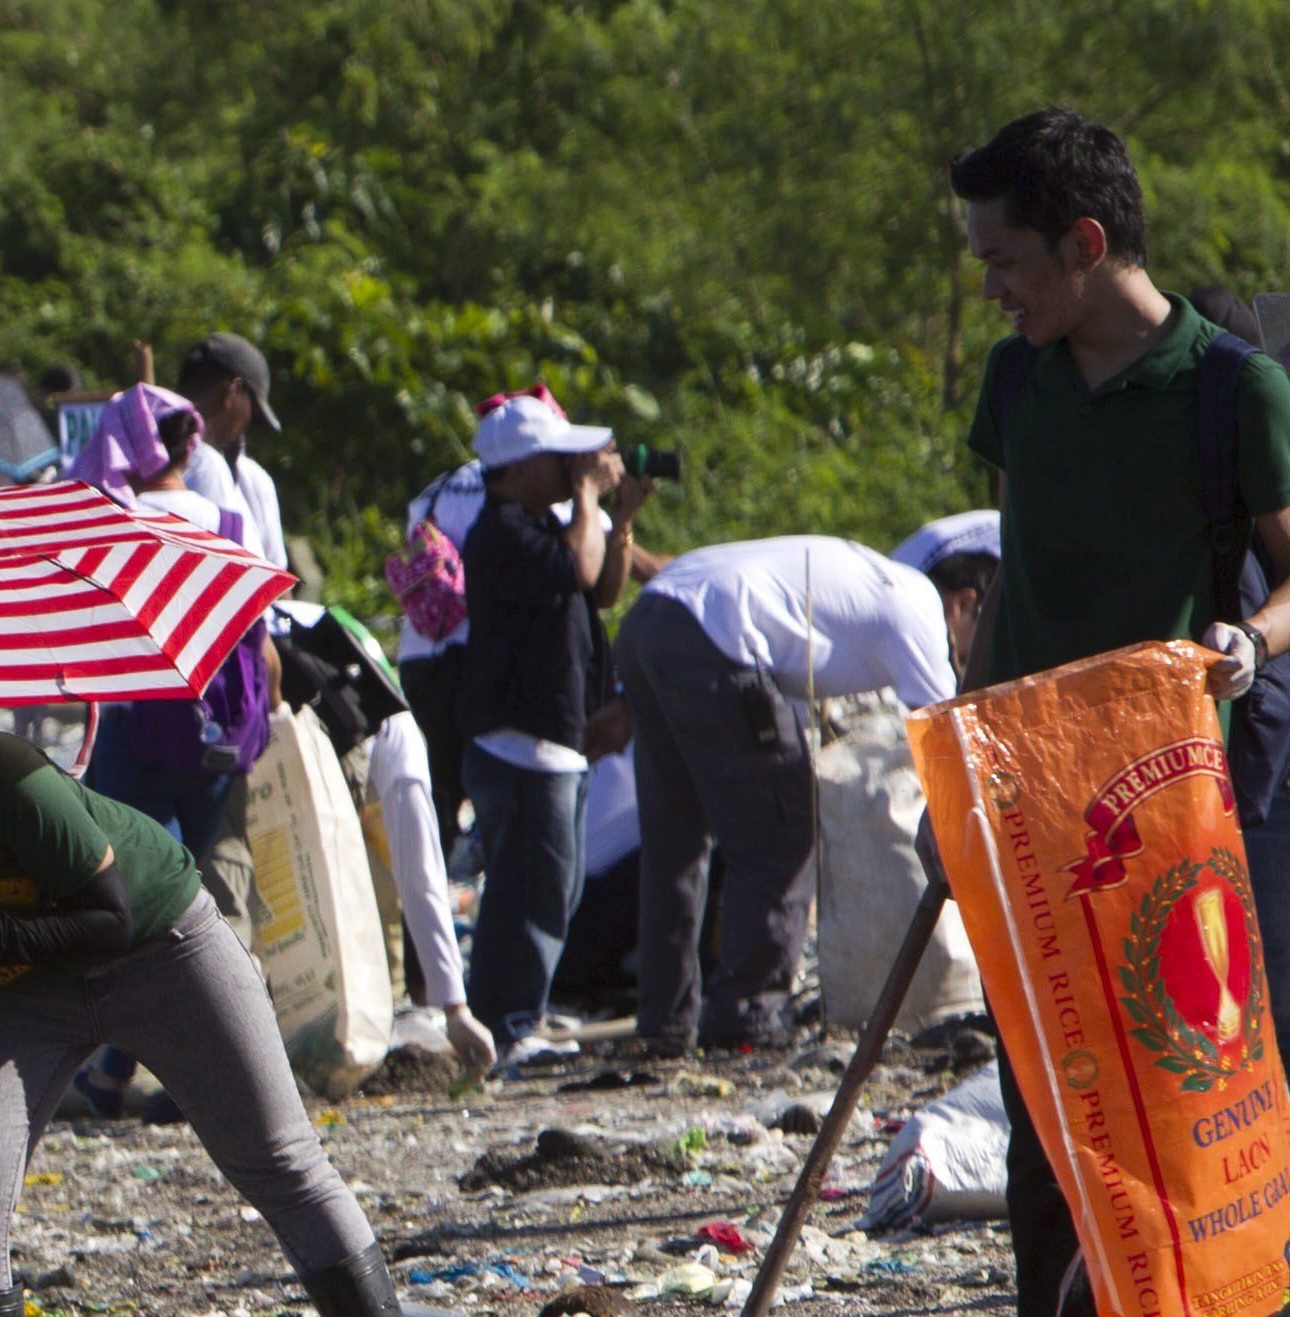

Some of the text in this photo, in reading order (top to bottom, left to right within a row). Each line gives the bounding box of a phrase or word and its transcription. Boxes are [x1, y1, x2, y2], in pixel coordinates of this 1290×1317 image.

[1004, 810, 1085, 1050] PREMIUM RICE
[1080, 1090, 1140, 1241] PREMIUM
[1188, 1190, 1264, 1244] WHOLE
